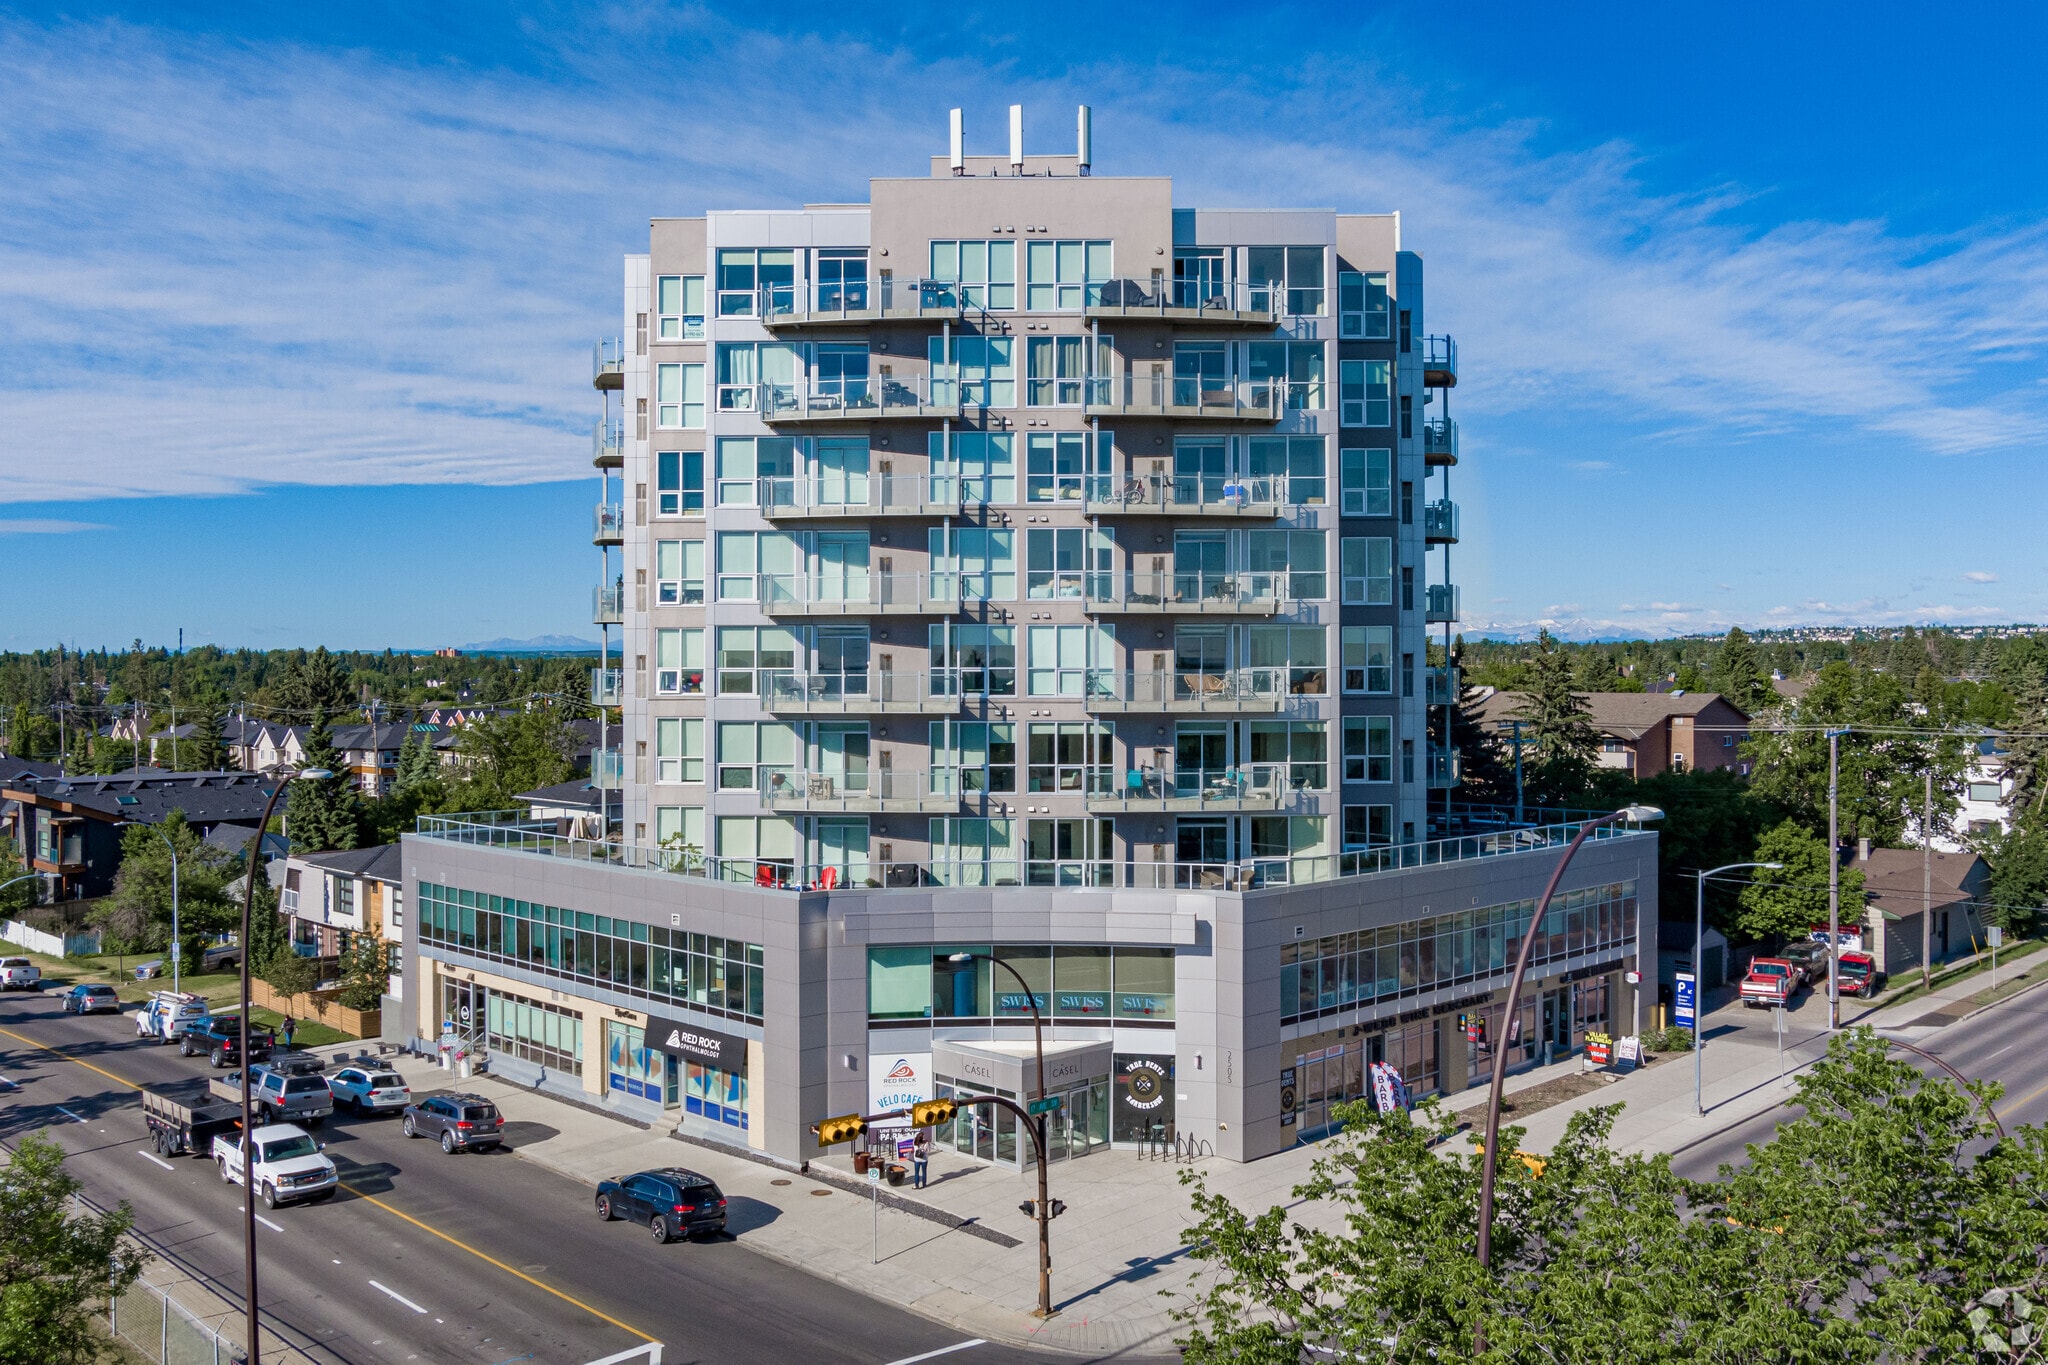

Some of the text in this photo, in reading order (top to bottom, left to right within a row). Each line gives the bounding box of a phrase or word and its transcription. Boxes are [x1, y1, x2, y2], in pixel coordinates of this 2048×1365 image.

[1061, 995, 1104, 1008] SWISS
[1123, 996, 1167, 1009] SWISS
[681, 1032, 722, 1051] RED ROCK
[680, 1043, 720, 1059] OPHTHALMOLOGY
[1125, 1060, 1143, 1073] TRUE
